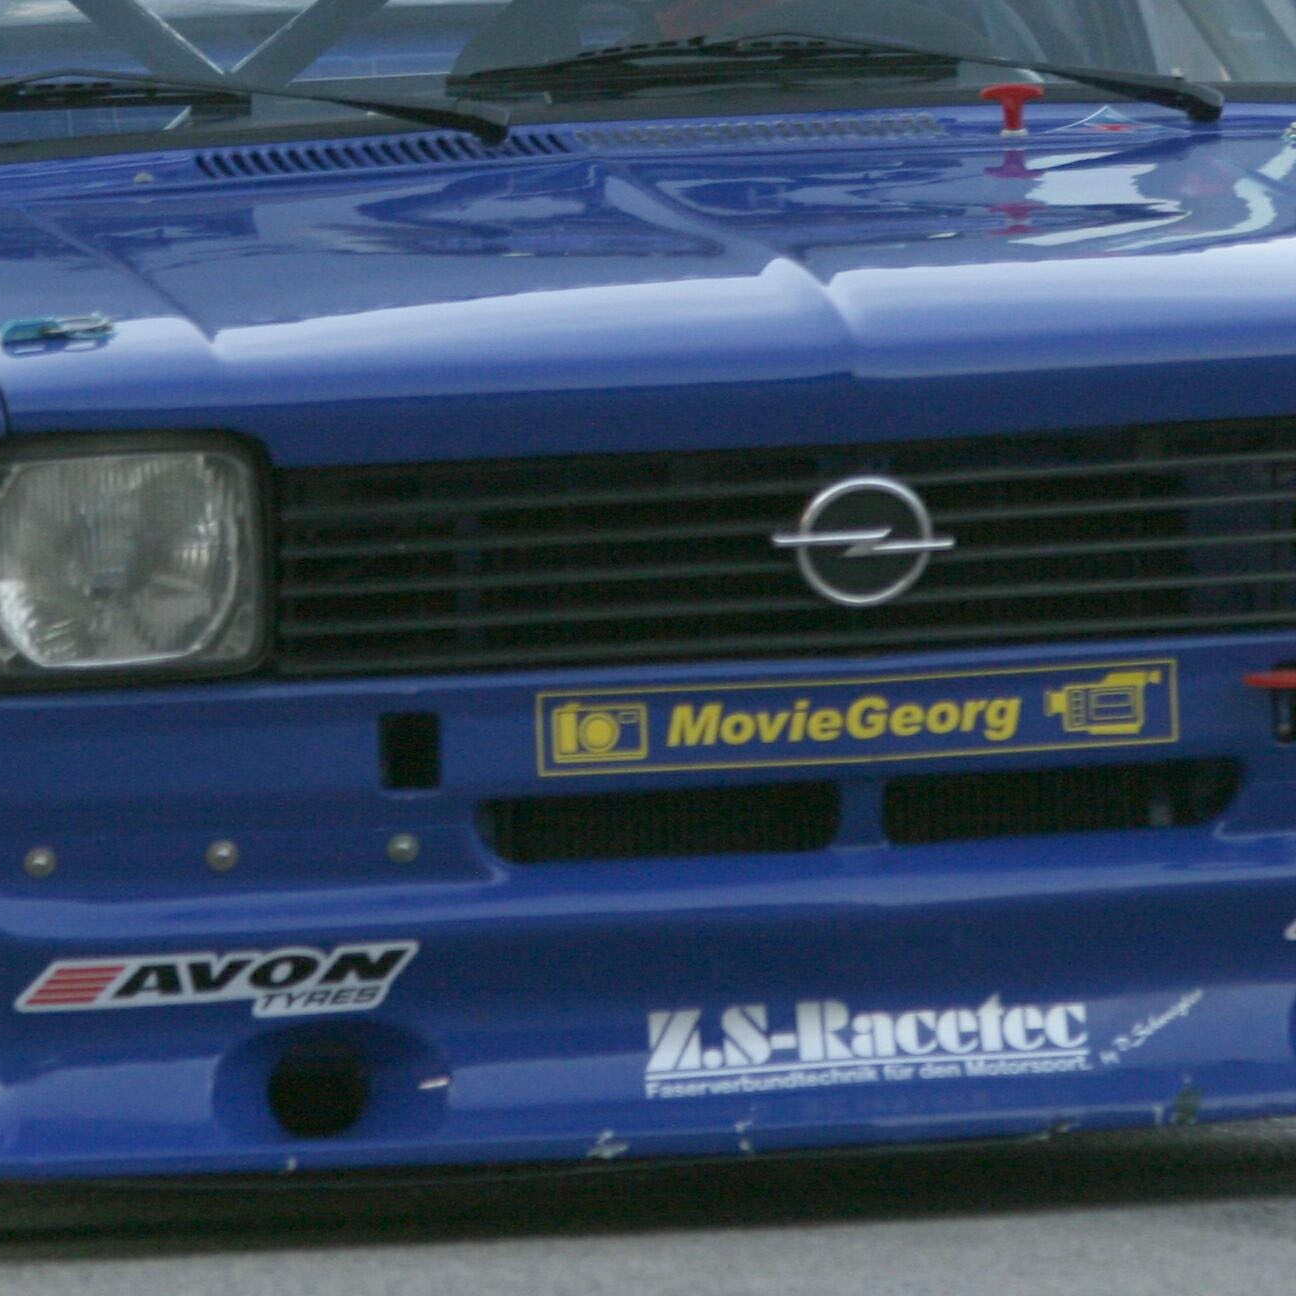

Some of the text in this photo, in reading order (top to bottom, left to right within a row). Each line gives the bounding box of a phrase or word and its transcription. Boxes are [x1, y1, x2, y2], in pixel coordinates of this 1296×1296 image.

[667, 694, 1022, 747] MovieGeorg
[111, 949, 410, 999] AVON
[260, 985, 381, 1011] TYRES
[645, 992, 1088, 1073] Z.S-Racetec
